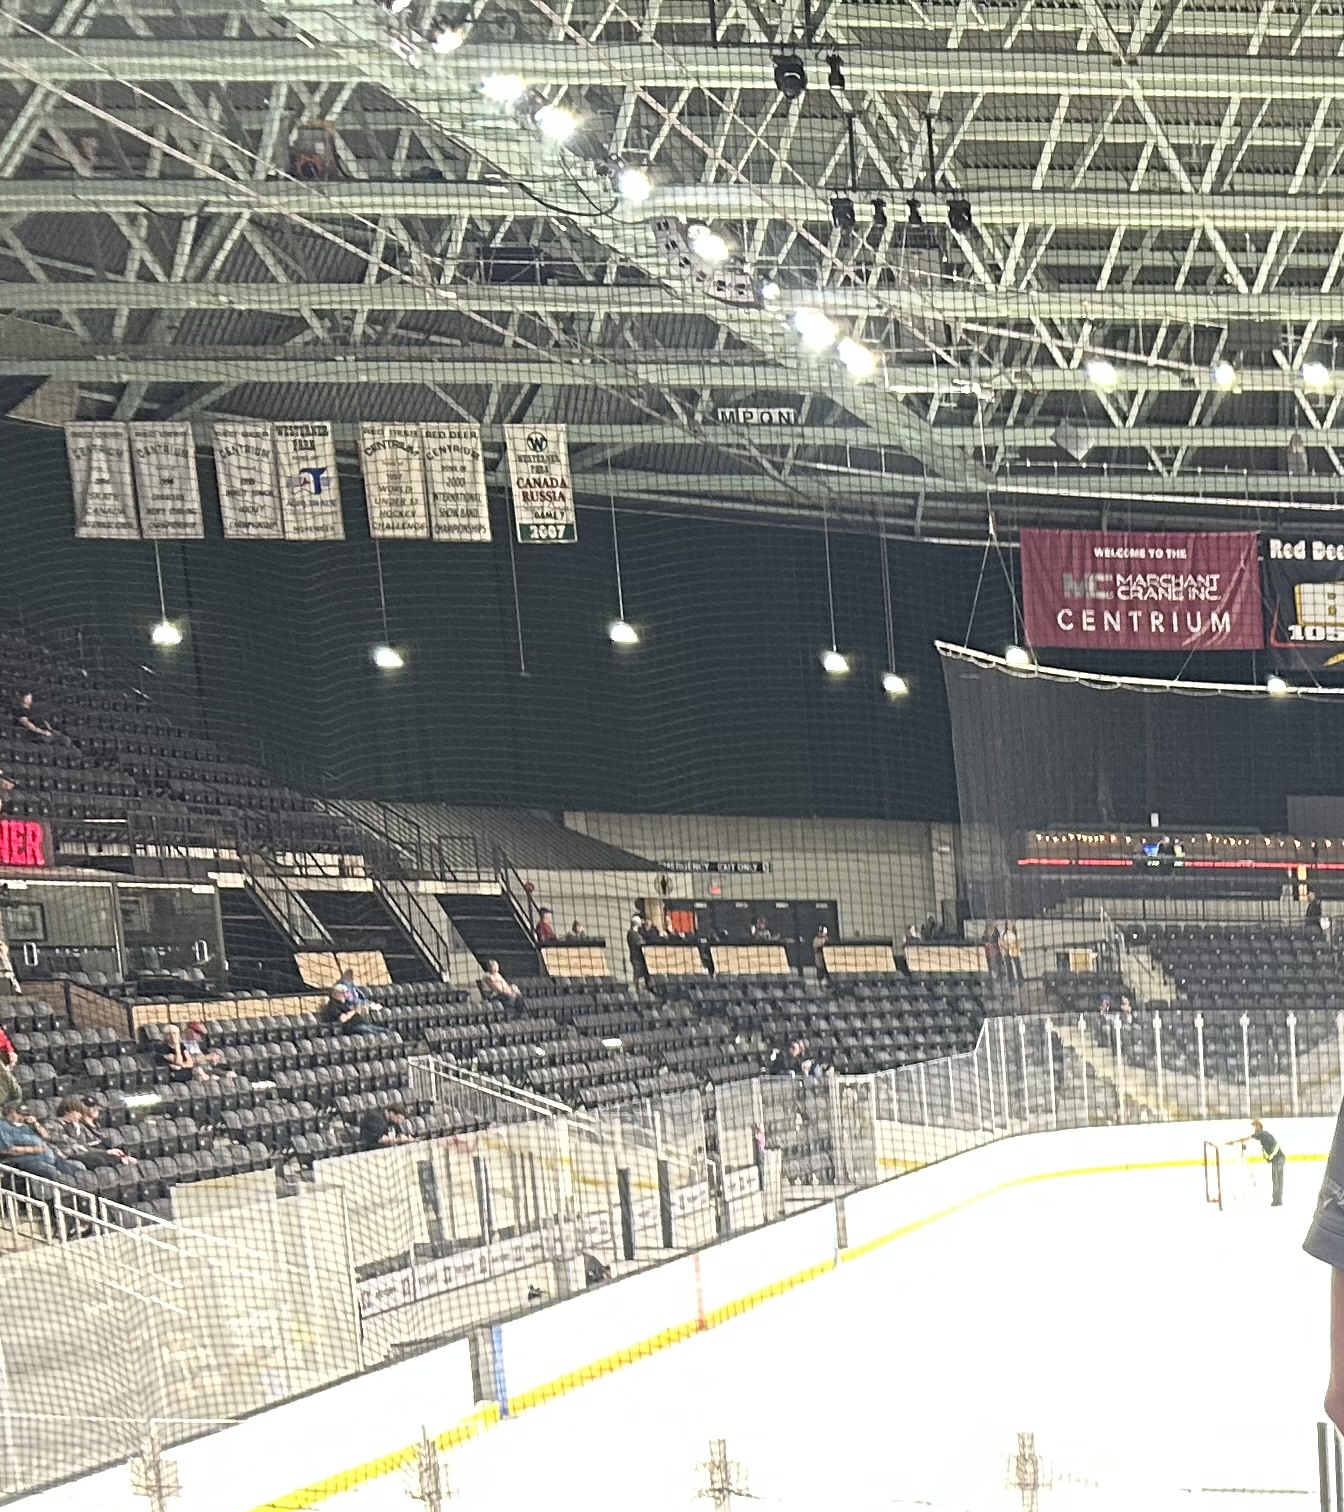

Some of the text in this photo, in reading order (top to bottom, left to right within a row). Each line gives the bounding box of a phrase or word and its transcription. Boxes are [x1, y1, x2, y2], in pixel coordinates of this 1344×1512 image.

[516, 477, 568, 489] CANADA
[521, 490, 566, 502] RUSSIA
[529, 524, 566, 539] 2007
[1094, 547, 1187, 560] WELCOME TO THE
[1269, 539, 1306, 560] Red
[1116, 573, 1221, 590] MARCHANT
[1116, 585, 1184, 601] CRANE
[1056, 608, 1231, 634] CENTRIUM
